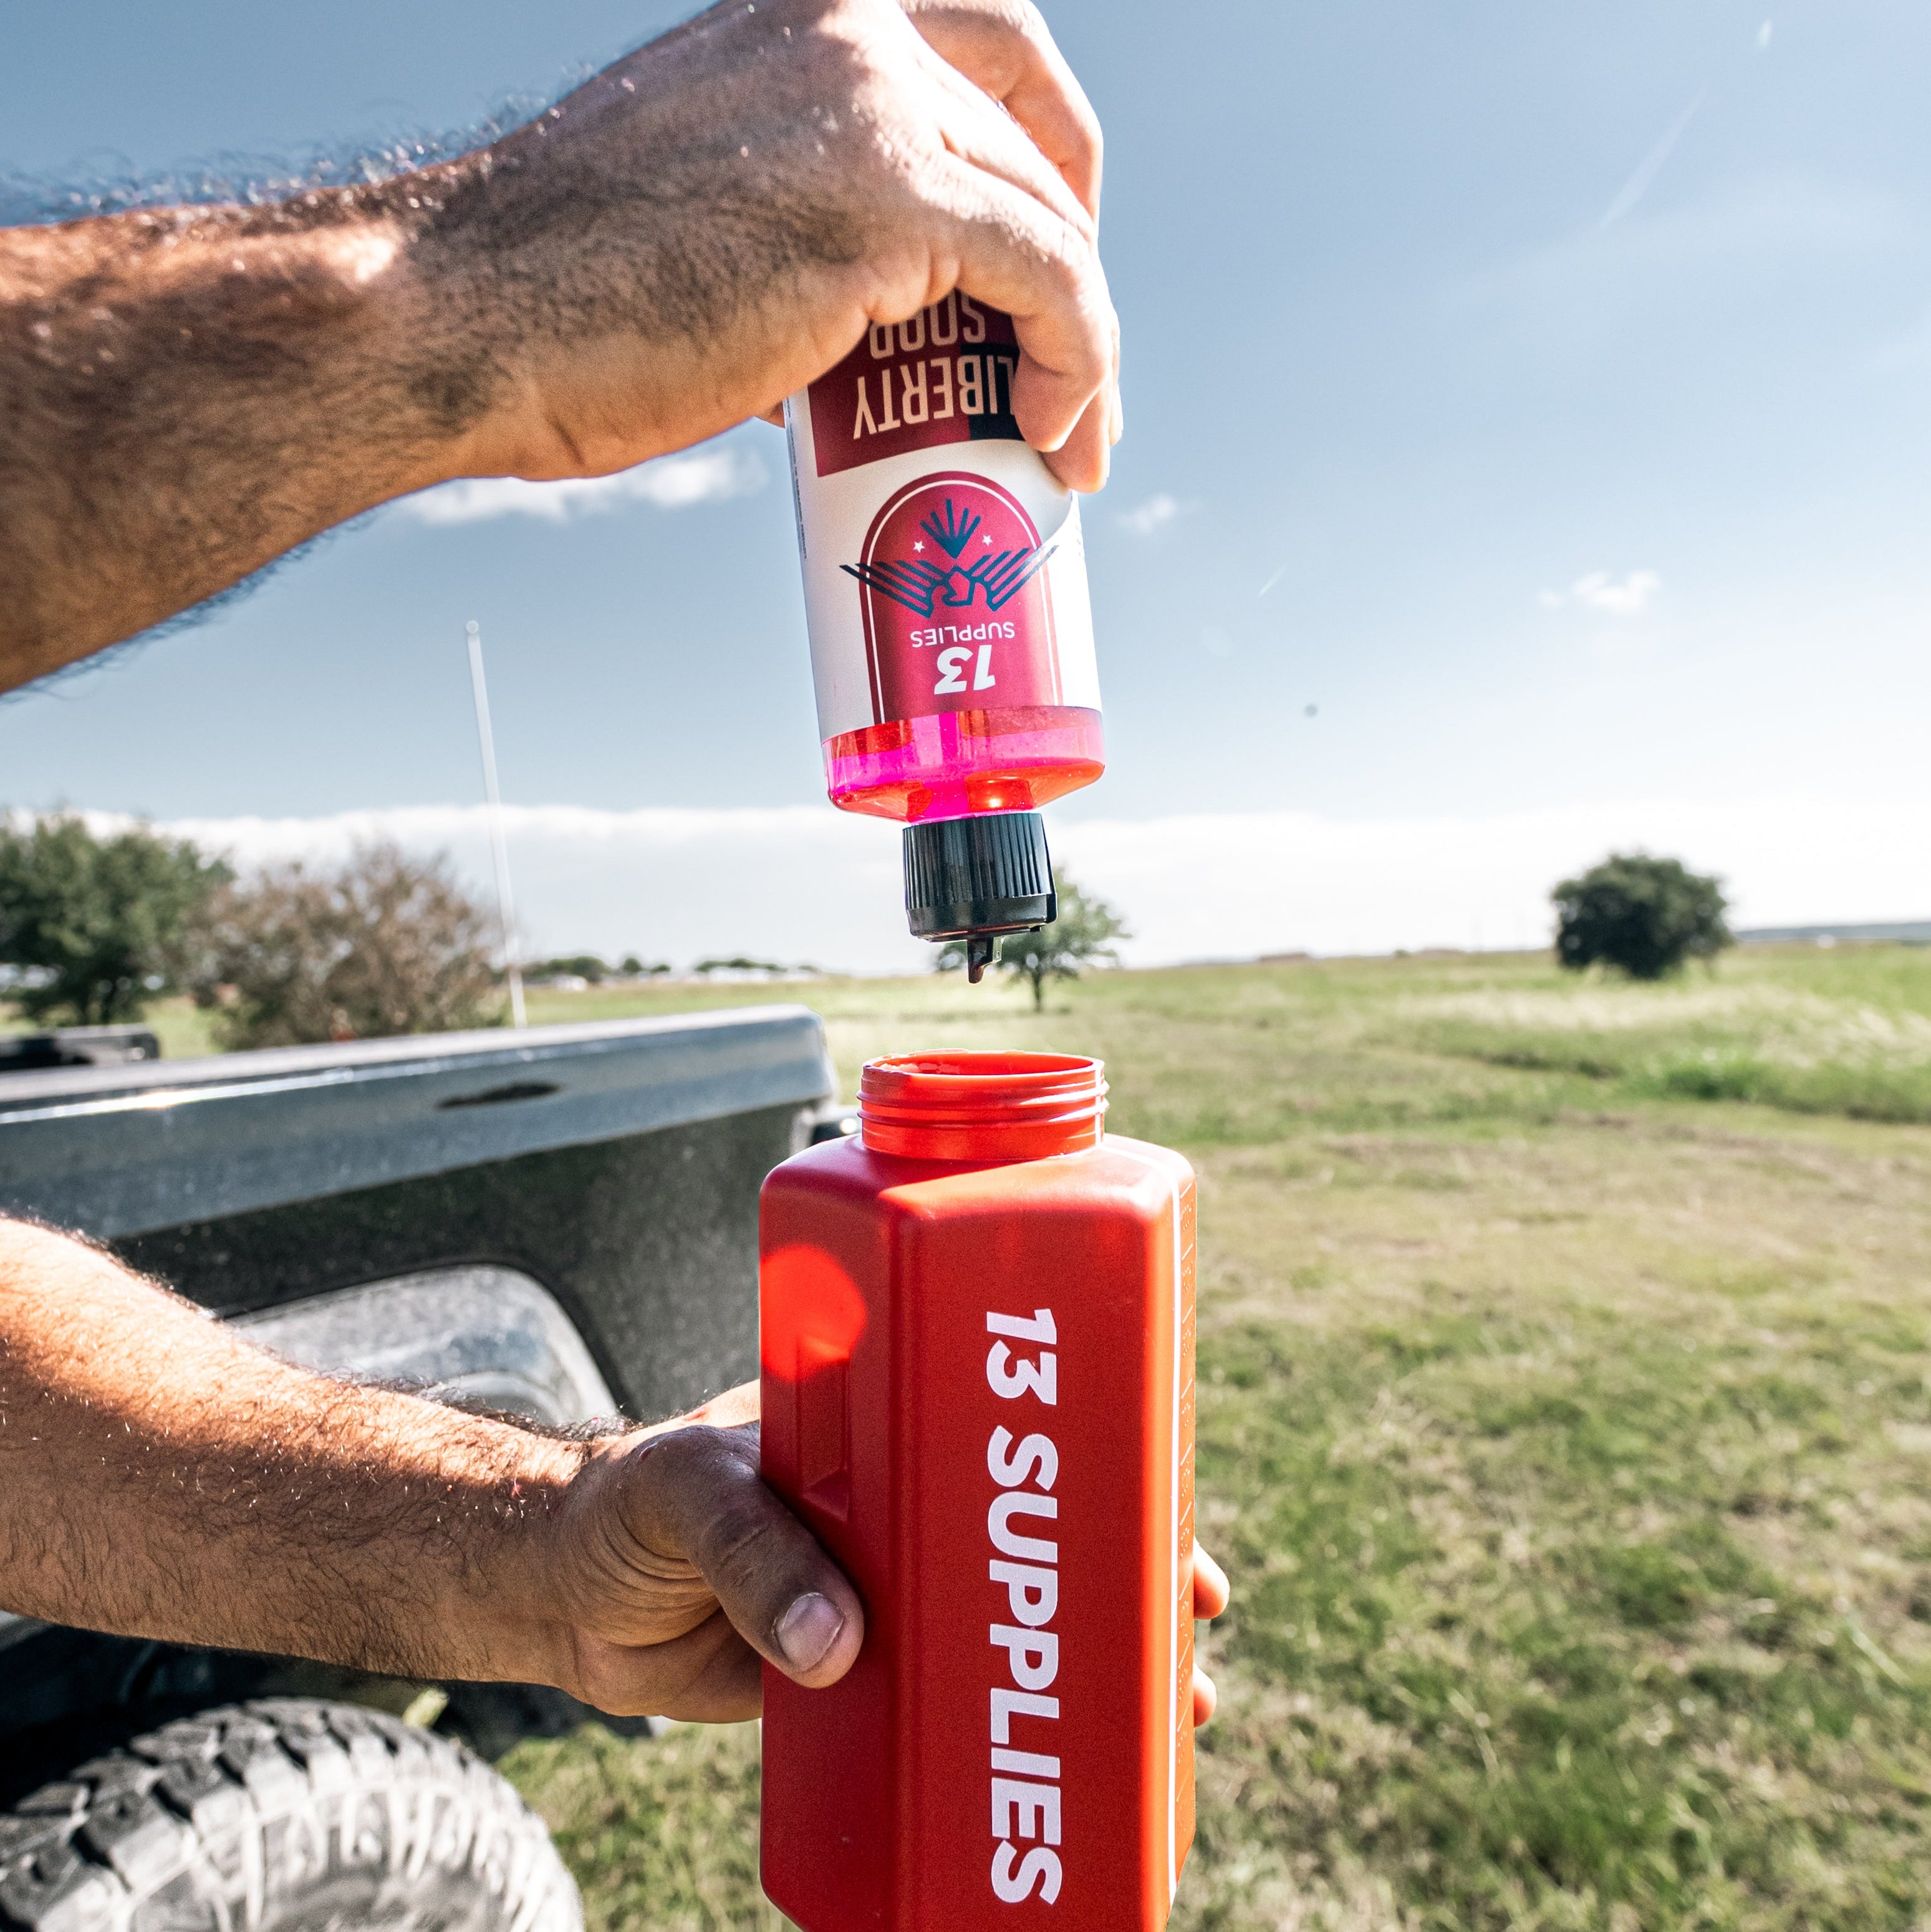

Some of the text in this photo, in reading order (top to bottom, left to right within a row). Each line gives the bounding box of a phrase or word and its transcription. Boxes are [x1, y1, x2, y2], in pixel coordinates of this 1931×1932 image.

[854, 354, 1014, 440] LIBERTY
[910, 621, 1016, 648] SUPPLIES
[933, 644, 996, 695] 13
[986, 1308, 1063, 1905] 13 SUPPLIES
